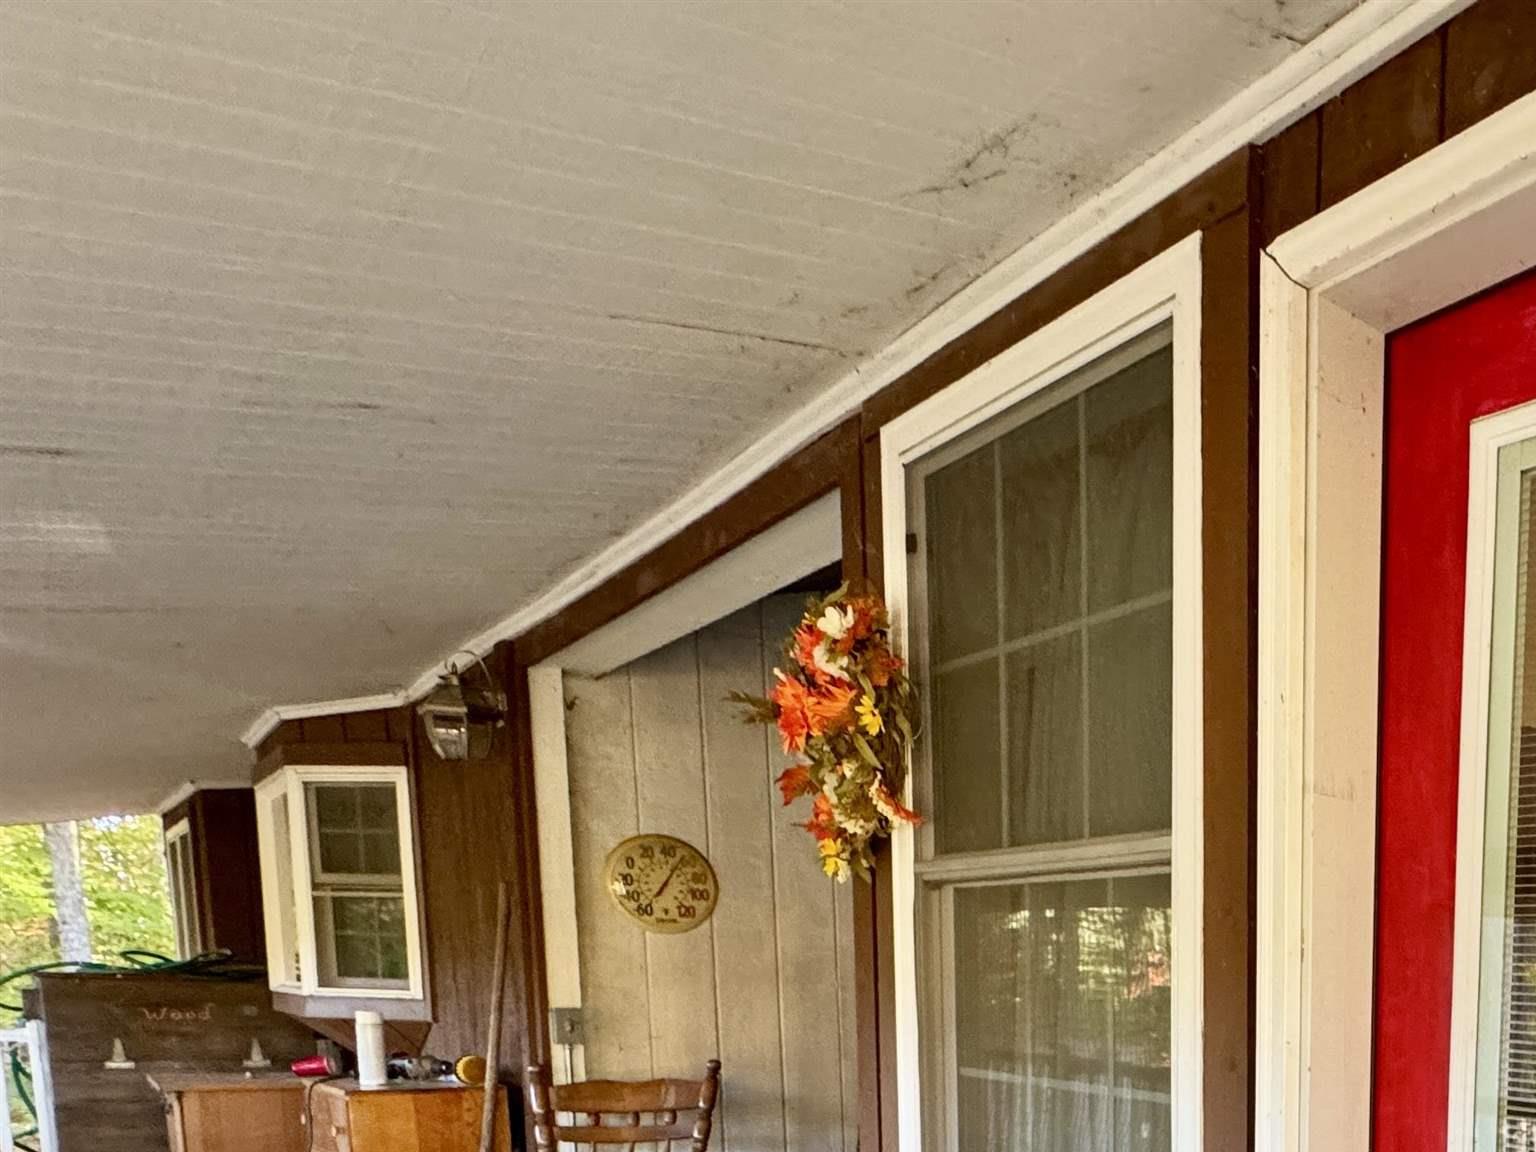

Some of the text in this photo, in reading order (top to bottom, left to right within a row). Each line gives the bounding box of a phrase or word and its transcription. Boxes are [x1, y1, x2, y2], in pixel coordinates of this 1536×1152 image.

[660, 844, 676, 858] 40
[625, 856, 635, 870] 0
[137, 1002, 216, 1021] Wood
